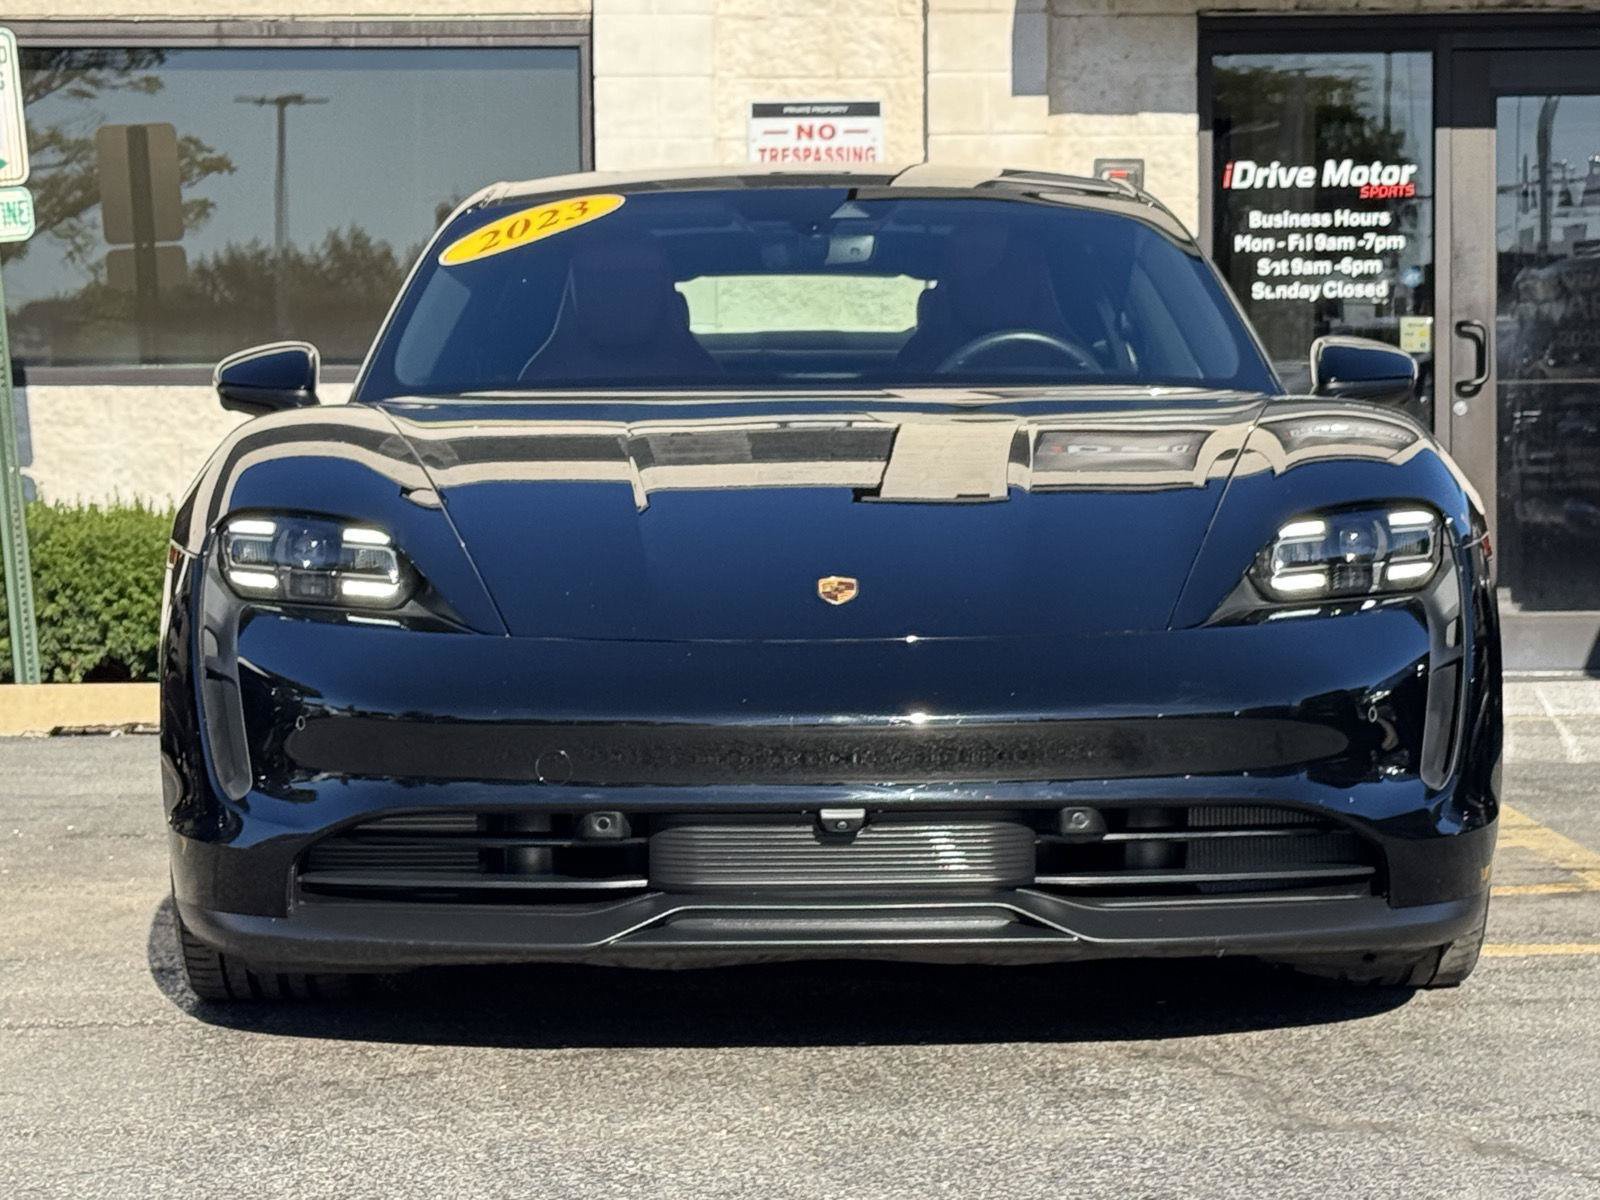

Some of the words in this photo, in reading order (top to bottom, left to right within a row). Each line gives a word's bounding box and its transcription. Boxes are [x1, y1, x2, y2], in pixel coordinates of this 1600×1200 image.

[796, 123, 836, 140] NO
[758, 146, 877, 163] TRESPASSING
[1223, 160, 1317, 190] iDrive
[1321, 158, 1418, 188] Motor
[1359, 183, 1415, 199] SPORTS
[479, 200, 589, 253] 2023
[1249, 210, 1333, 229] Business
[1334, 208, 1391, 228] Hours
[1234, 234, 1276, 252] Mon
[1314, 233, 1356, 251] 9am
[1322, 279, 1389, 299] Closed
